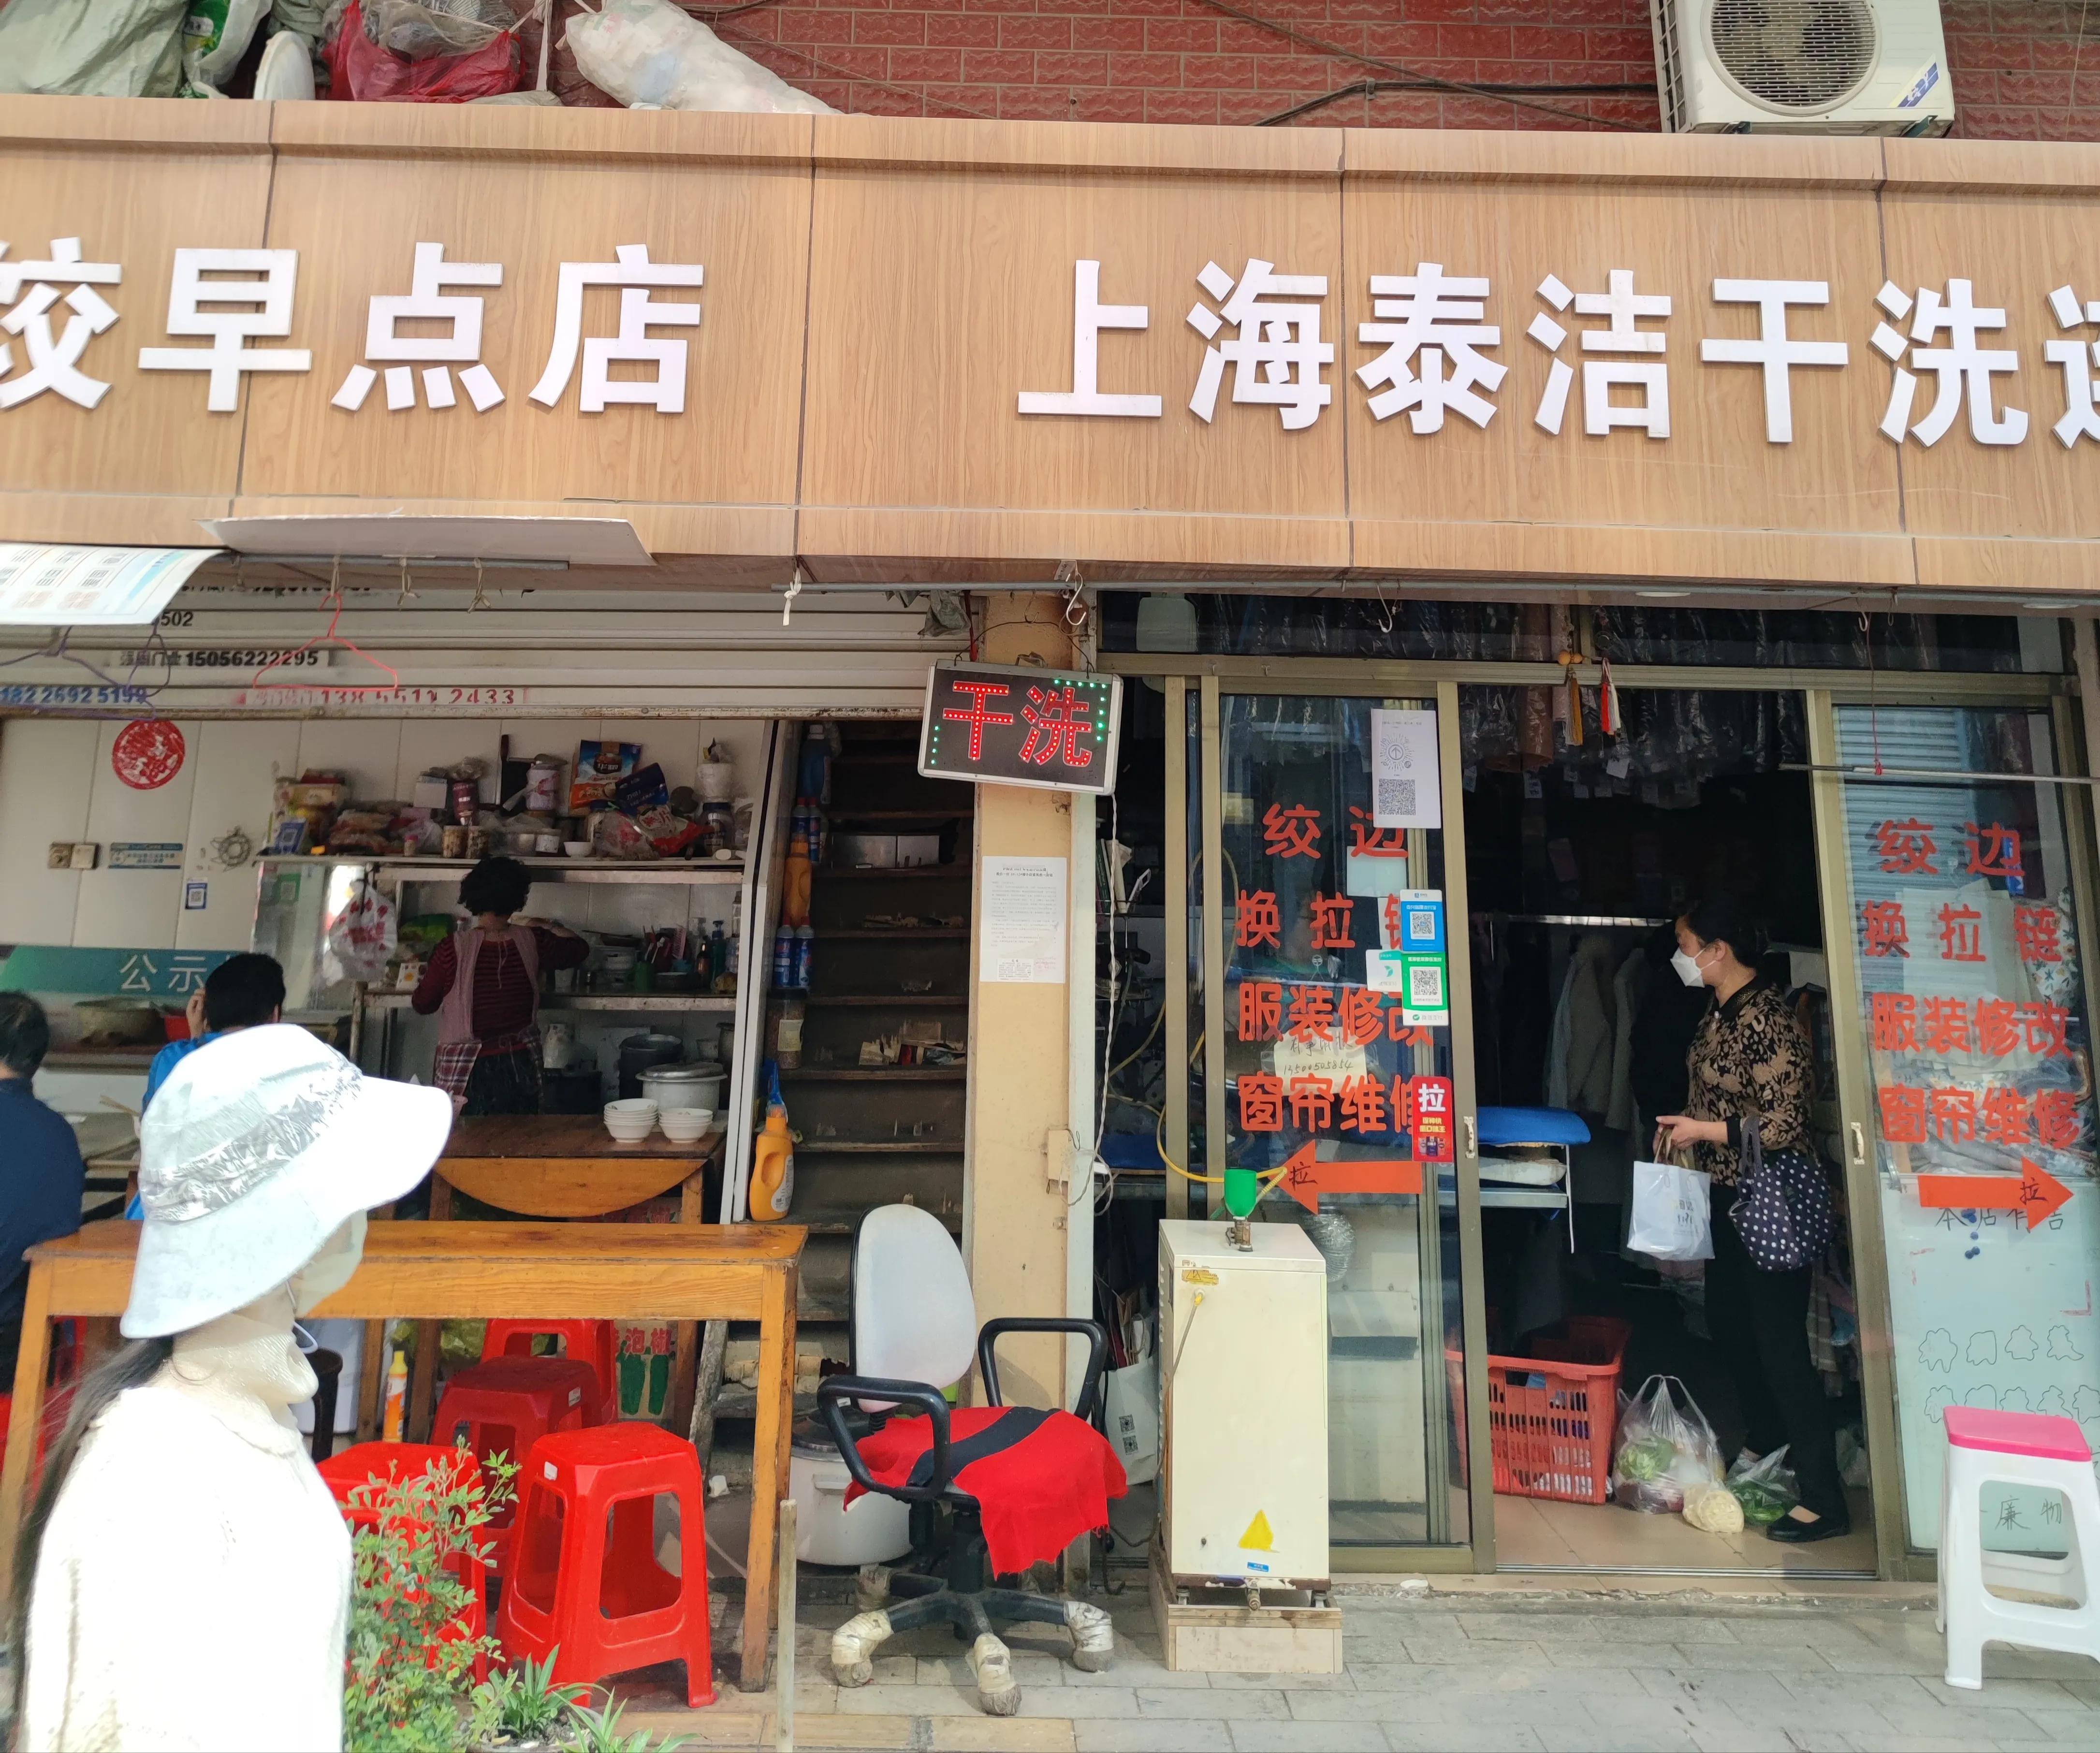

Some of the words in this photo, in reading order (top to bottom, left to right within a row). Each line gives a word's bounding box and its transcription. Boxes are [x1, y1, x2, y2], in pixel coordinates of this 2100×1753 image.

[943, 680, 1092, 767] 干洗
[1877, 818, 2025, 876] 绞边
[1862, 899, 2062, 962] 换拉链
[120, 954, 232, 993] 公示
[1872, 992, 2073, 1058] 服装修改
[1418, 1083, 1446, 1112] 拉
[1878, 1083, 2080, 1149] 窗帘维修
[1288, 1162, 1318, 1191] 拉
[2019, 1178, 2048, 1204] 拉
